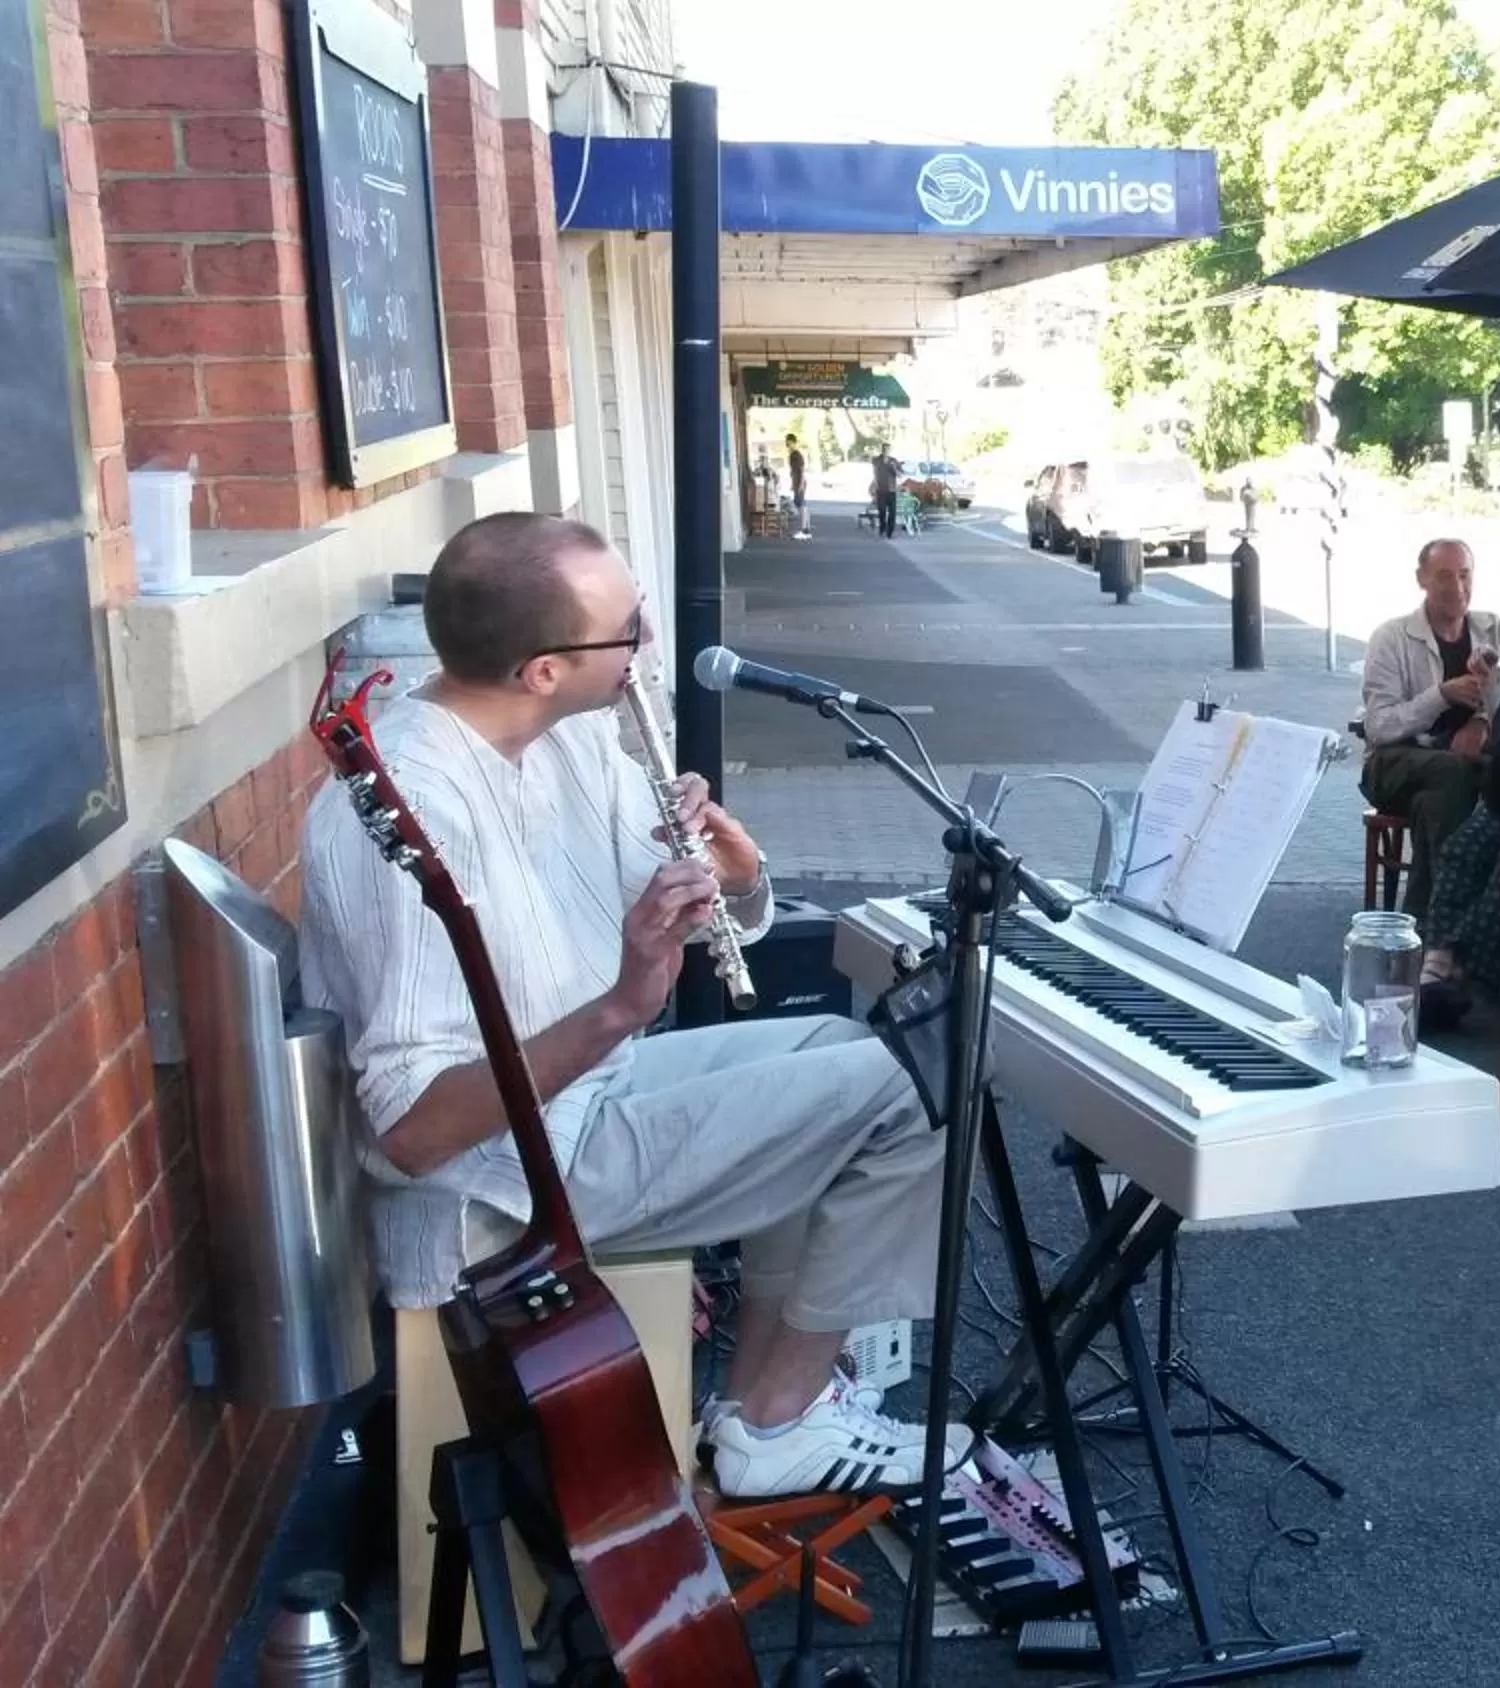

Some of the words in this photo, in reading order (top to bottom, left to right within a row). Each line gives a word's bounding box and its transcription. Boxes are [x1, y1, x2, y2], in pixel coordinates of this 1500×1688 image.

[1000, 168, 1175, 214] Vinnies
[752, 394, 779, 407] The
[783, 394, 840, 408] Corner
[841, 394, 888, 408] Crafts
